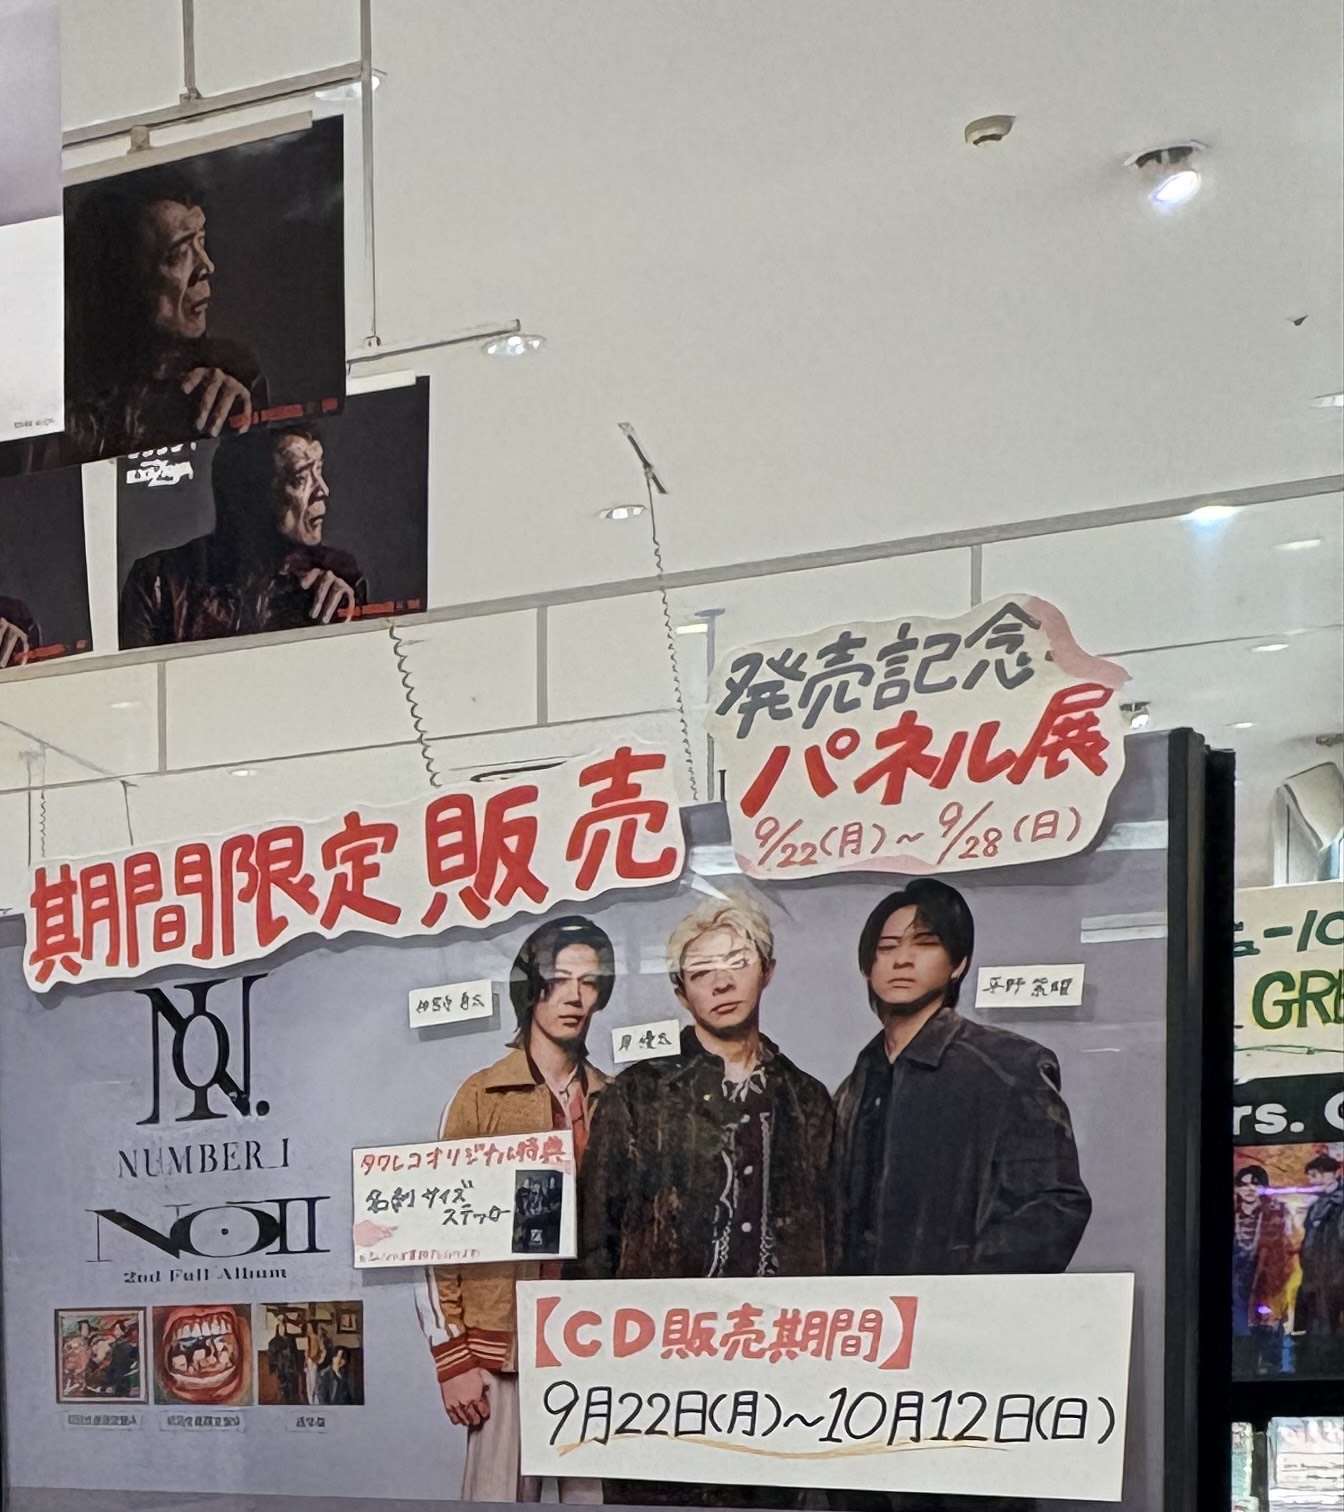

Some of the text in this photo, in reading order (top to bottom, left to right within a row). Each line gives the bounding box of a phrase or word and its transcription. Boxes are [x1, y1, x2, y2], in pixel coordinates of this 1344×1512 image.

[716, 602, 1056, 739] 発売記念
[741, 682, 1114, 817] パネル展
[29, 746, 679, 983] 期間限定販売
[1233, 1103, 1304, 1136] rs.
